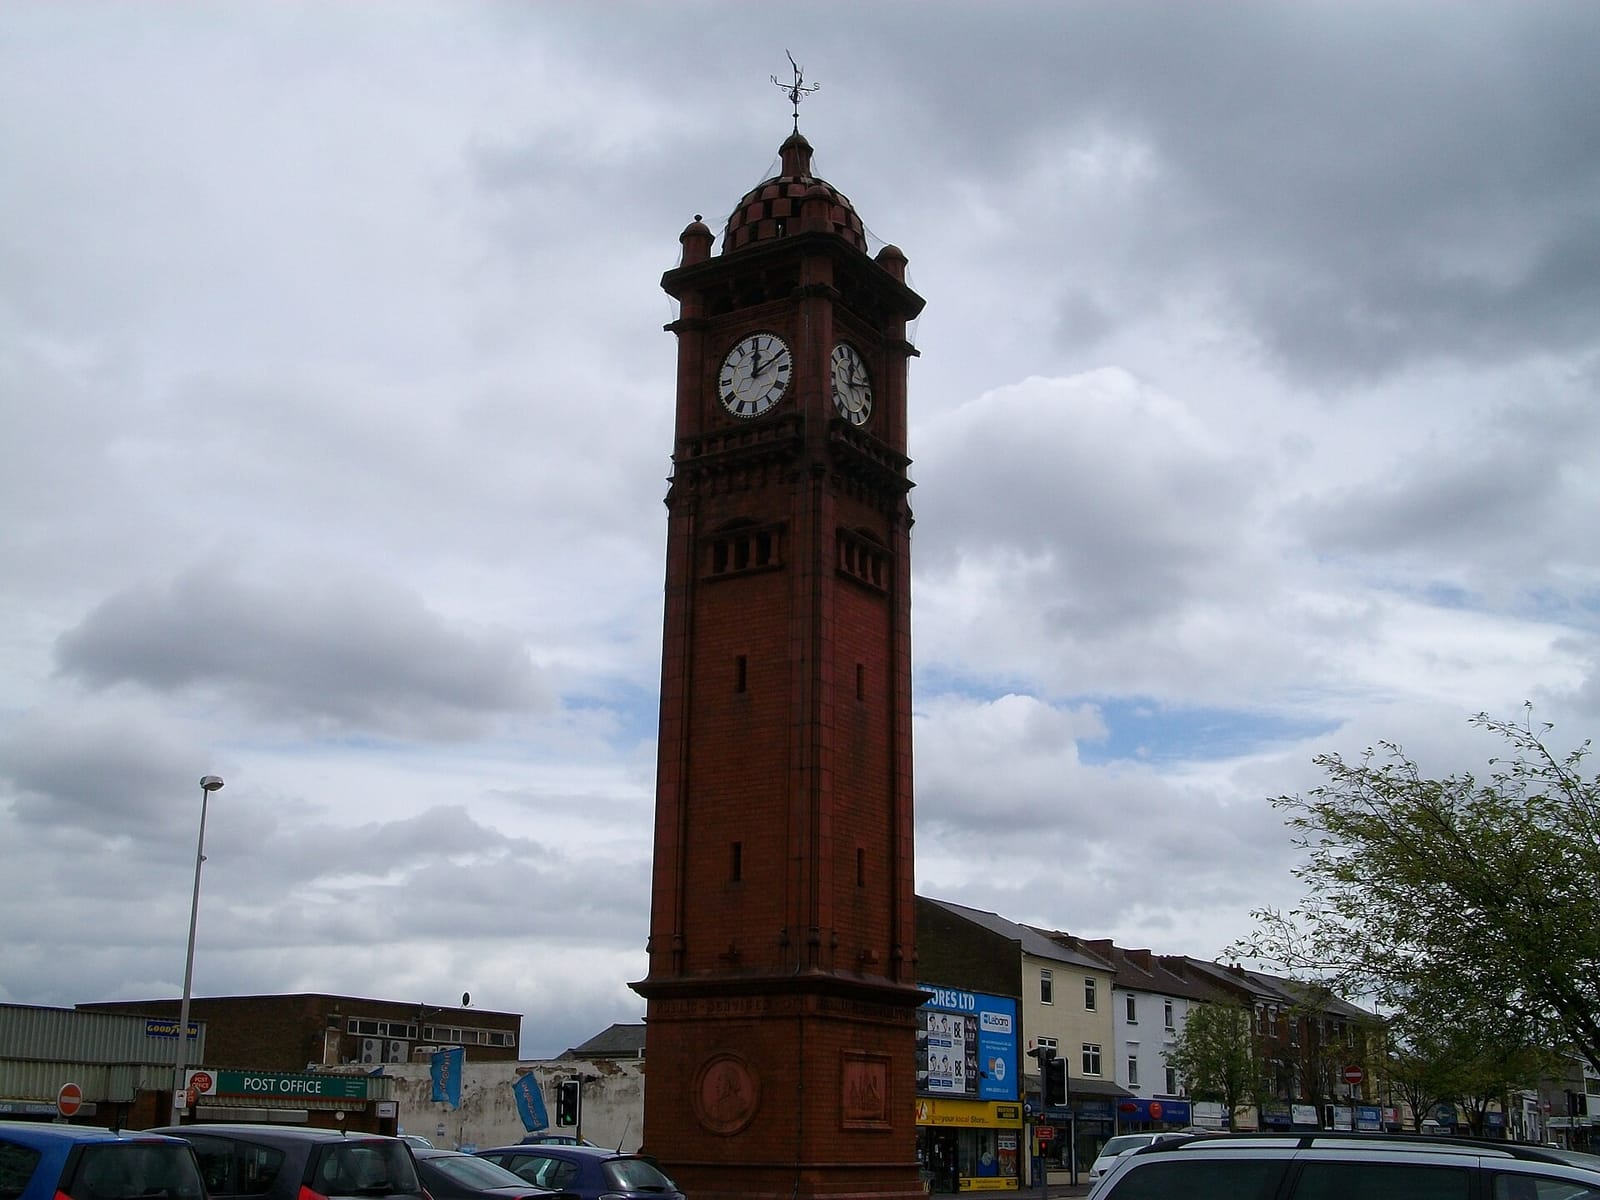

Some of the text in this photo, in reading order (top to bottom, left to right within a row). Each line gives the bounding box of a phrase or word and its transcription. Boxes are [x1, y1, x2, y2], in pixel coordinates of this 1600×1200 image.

[920, 987, 975, 1011] ORES LTD
[147, 1024, 198, 1035] GOODYAR
[243, 1077, 322, 1094] POST OFFICE
